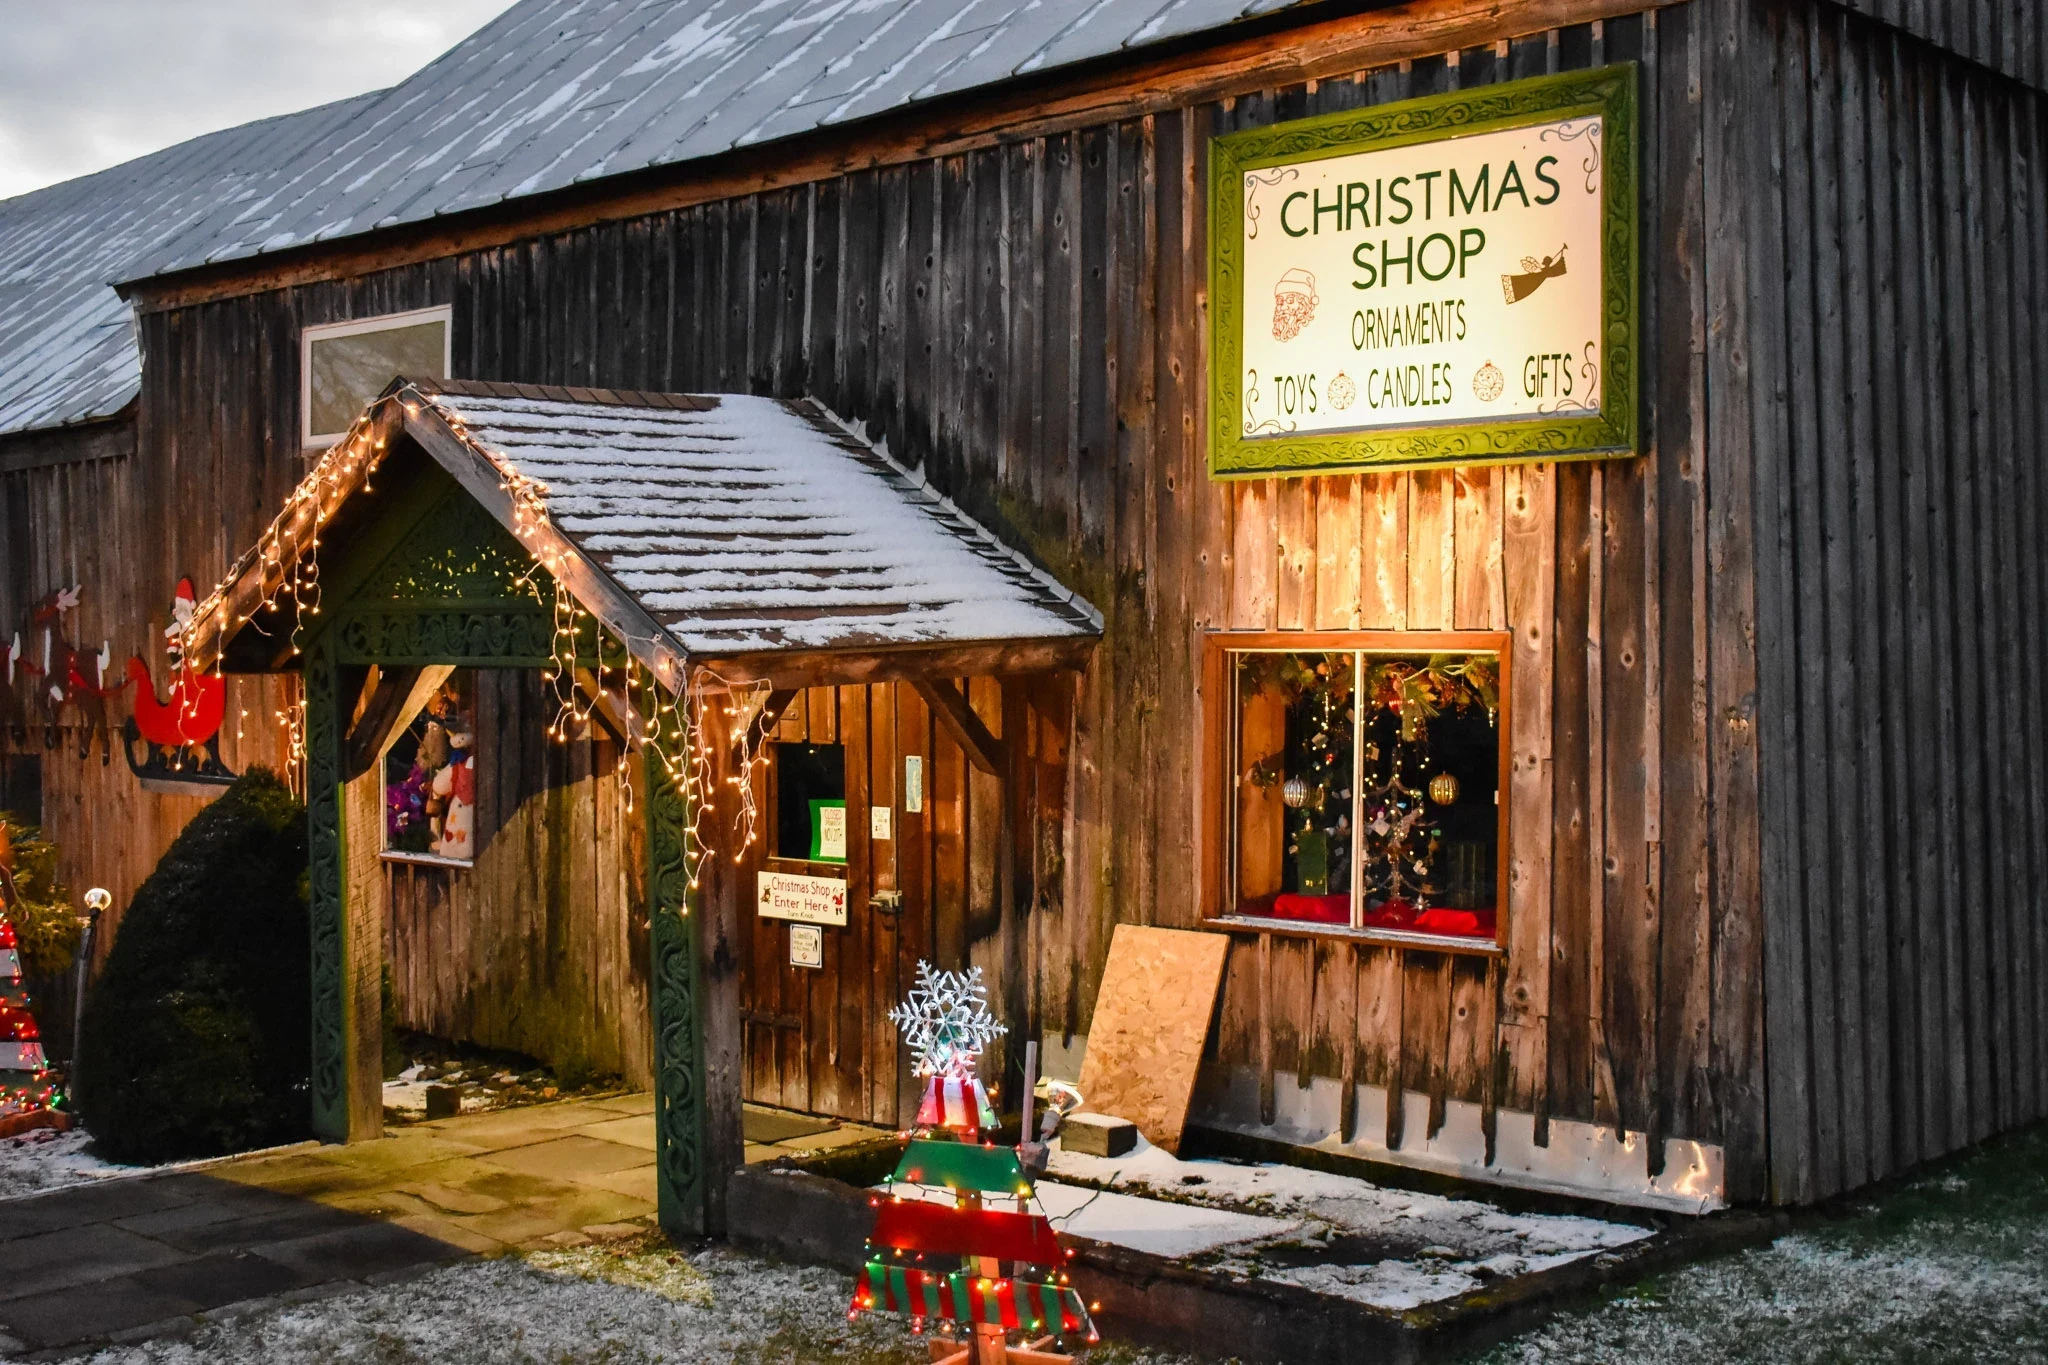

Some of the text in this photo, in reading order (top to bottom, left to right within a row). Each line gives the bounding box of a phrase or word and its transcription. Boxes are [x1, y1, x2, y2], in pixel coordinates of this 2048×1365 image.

[1281, 156, 1560, 237] CHRISTMAS
[1352, 228, 1485, 289] SHOP
[1352, 299, 1465, 350] ORNAMENTS
[1275, 353, 1572, 415] TOYS CANDLES GIFTS
[824, 808, 842, 820] CLOSED
[772, 876, 830, 899] Christmas Shop
[774, 895, 828, 912] Enter Here
[800, 911, 814, 919] Knob
